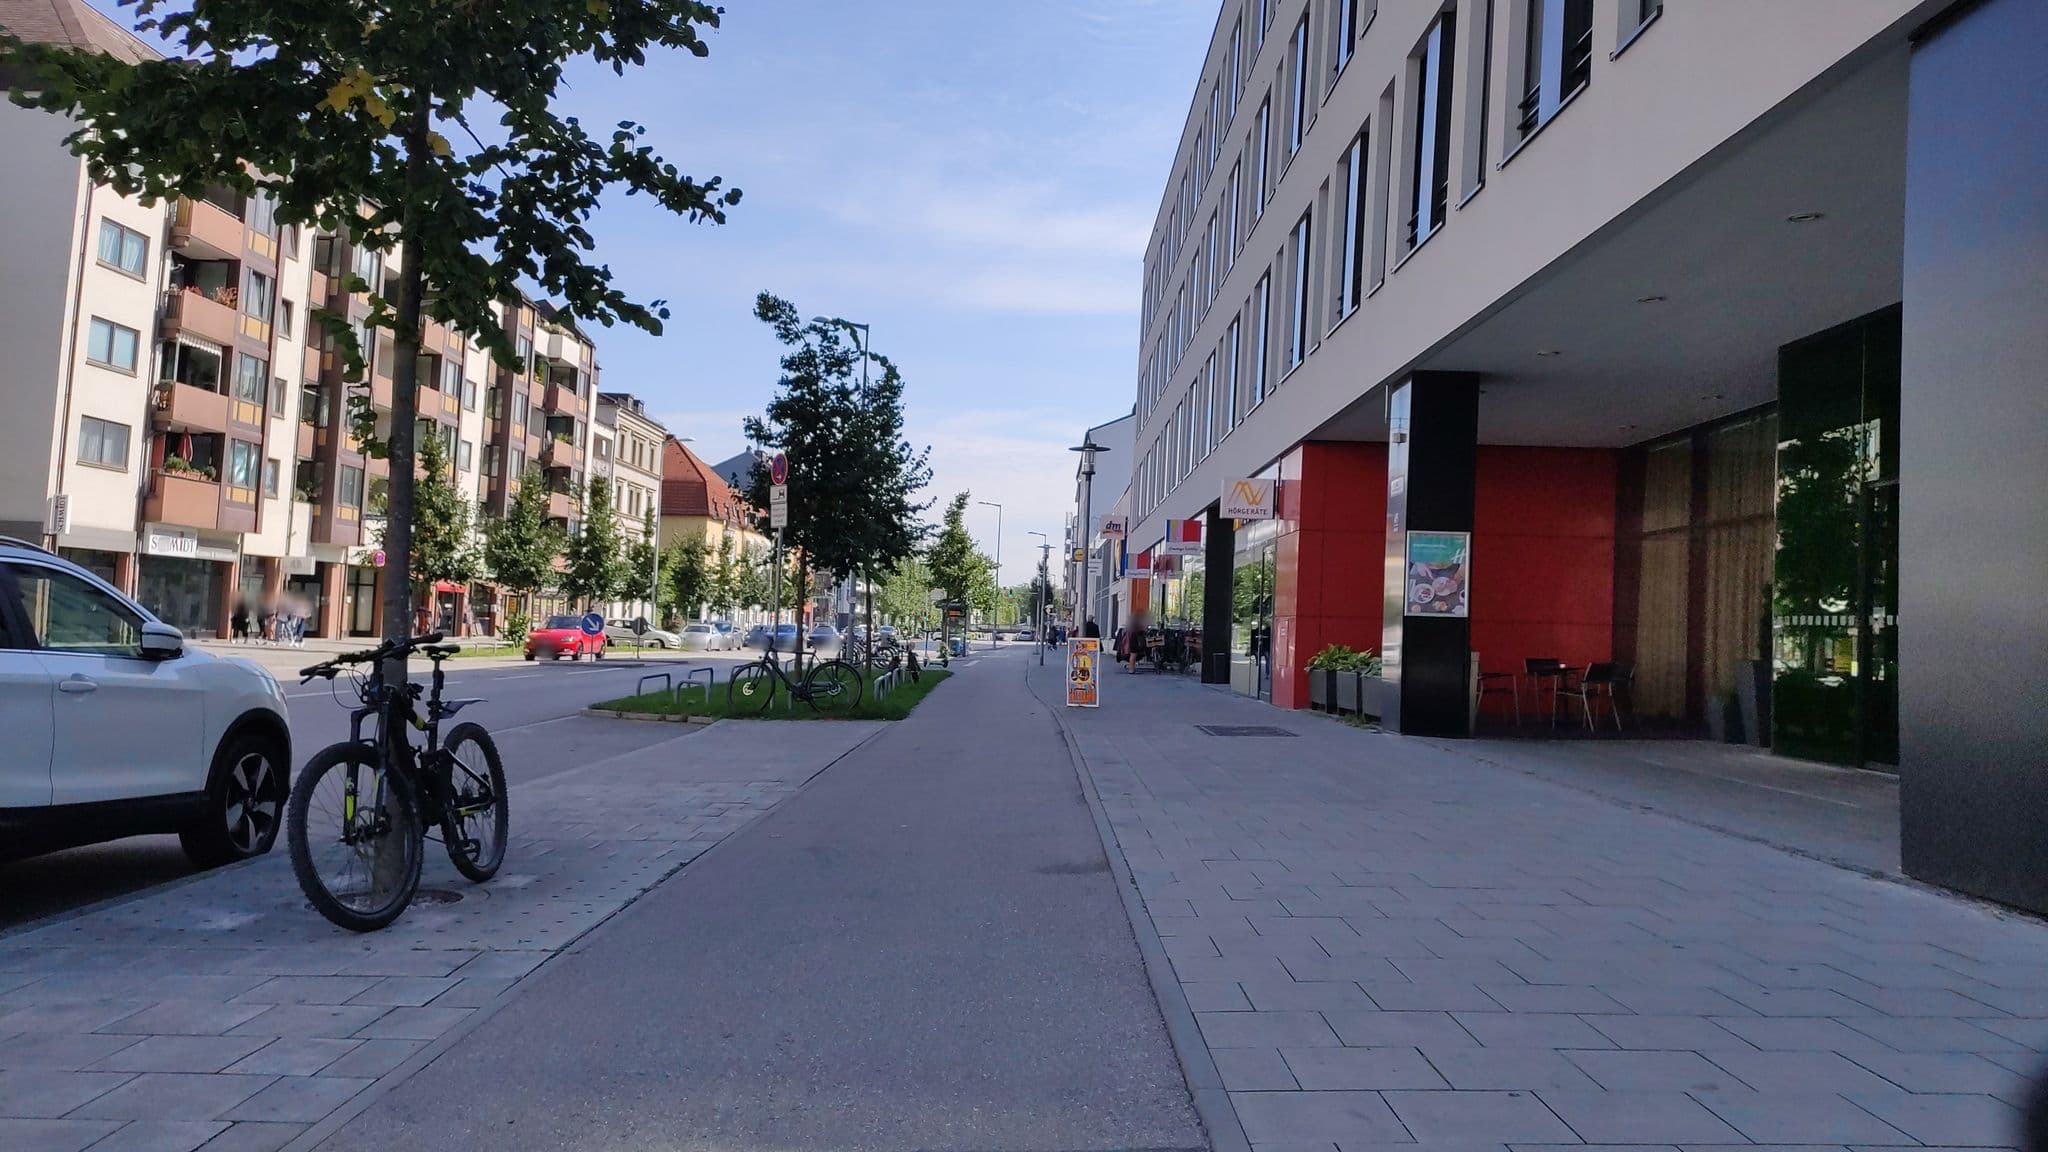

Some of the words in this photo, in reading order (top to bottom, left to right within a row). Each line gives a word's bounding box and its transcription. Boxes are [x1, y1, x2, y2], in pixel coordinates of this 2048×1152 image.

[1228, 506, 1267, 515] HÖRGERÄTE
[1106, 520, 1121, 530] dm
[151, 536, 194, 553] SMIDT
